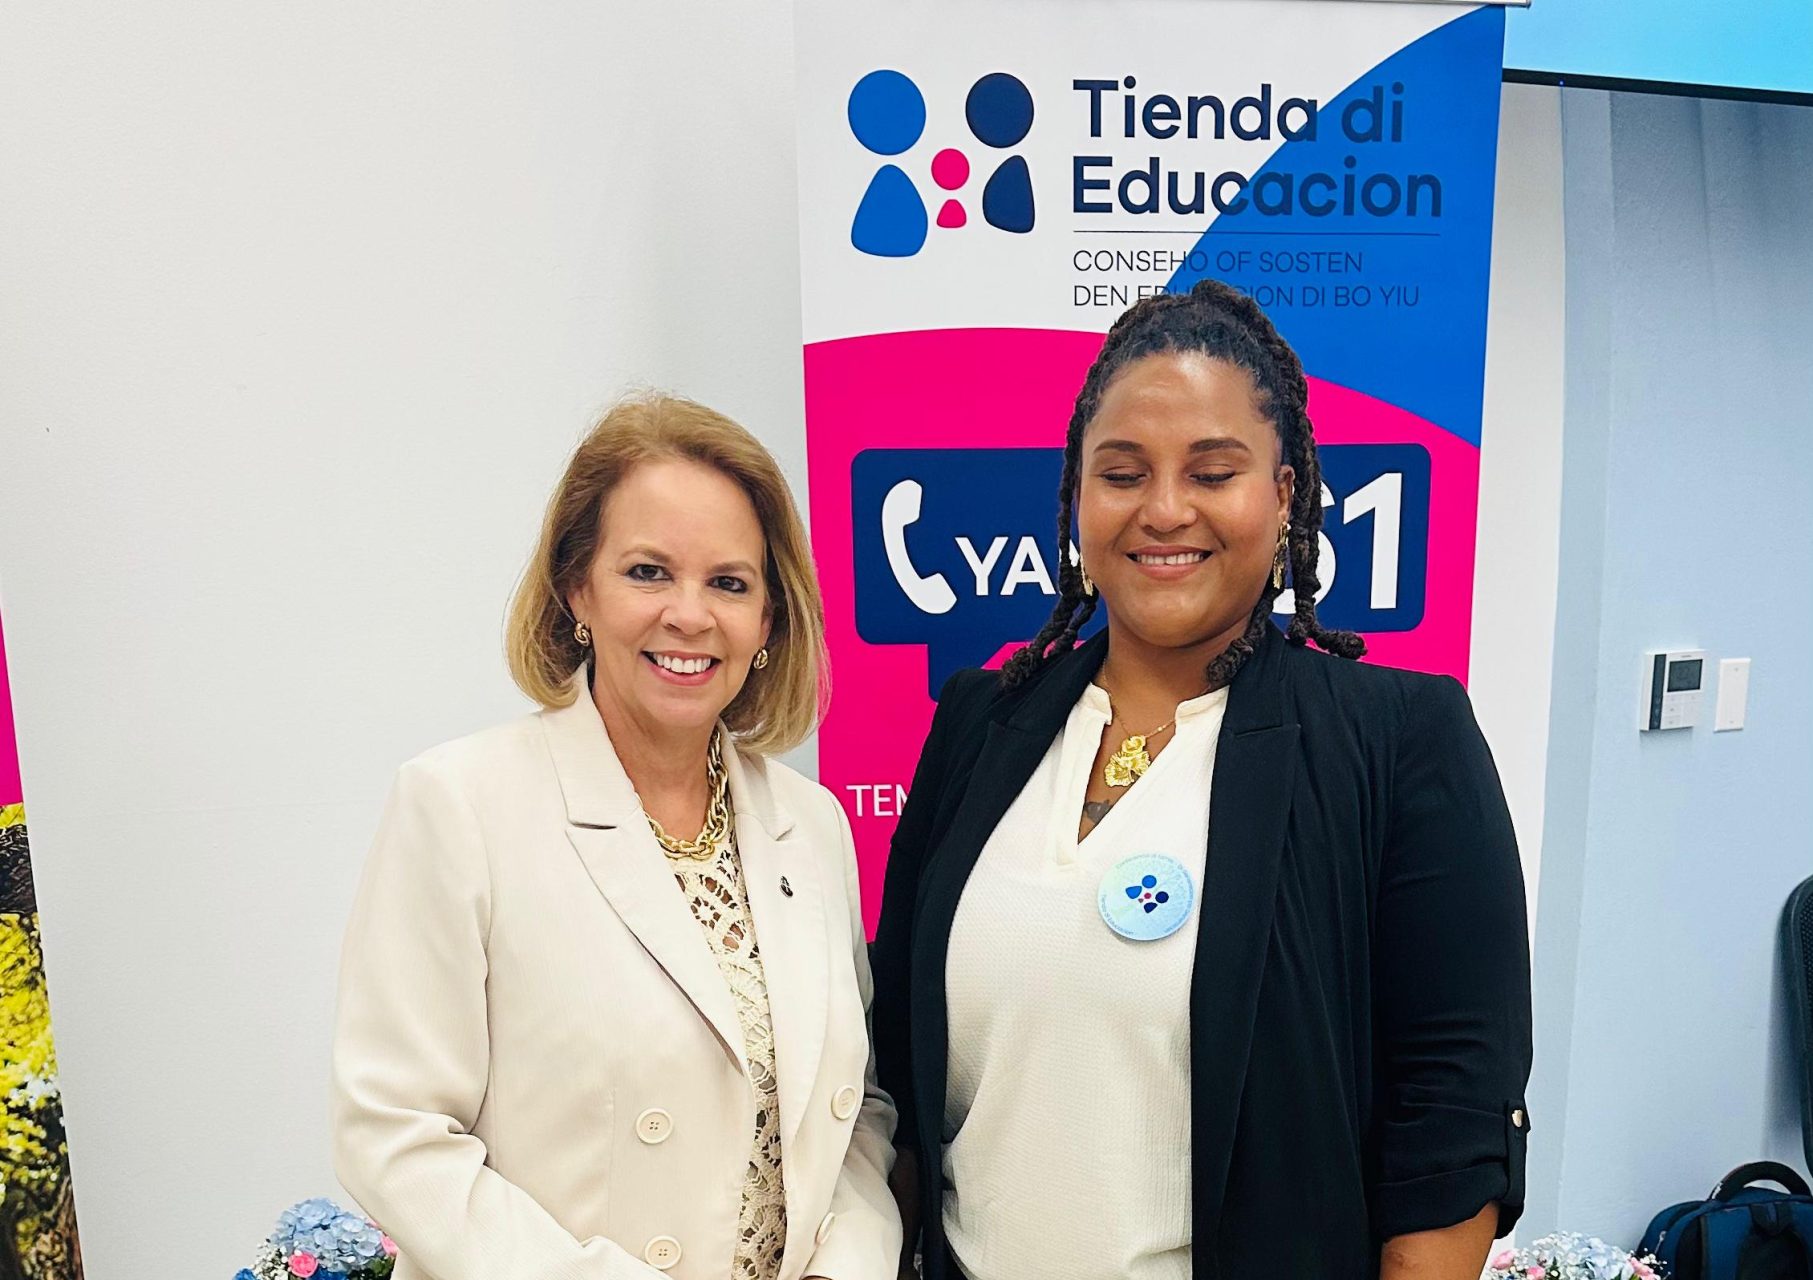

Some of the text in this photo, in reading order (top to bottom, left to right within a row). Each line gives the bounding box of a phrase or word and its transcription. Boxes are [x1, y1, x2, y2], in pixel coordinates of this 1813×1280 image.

[1073, 75, 1405, 144] Tienda di
[1073, 155, 1443, 218] Educacion
[1073, 250, 1363, 273] CONSEHO OF SOSTEN
[1073, 285, 1128, 307] DEN
[1302, 286, 1326, 307] DI
[1334, 285, 1372, 308] BO
[1380, 286, 1420, 308] YIU
